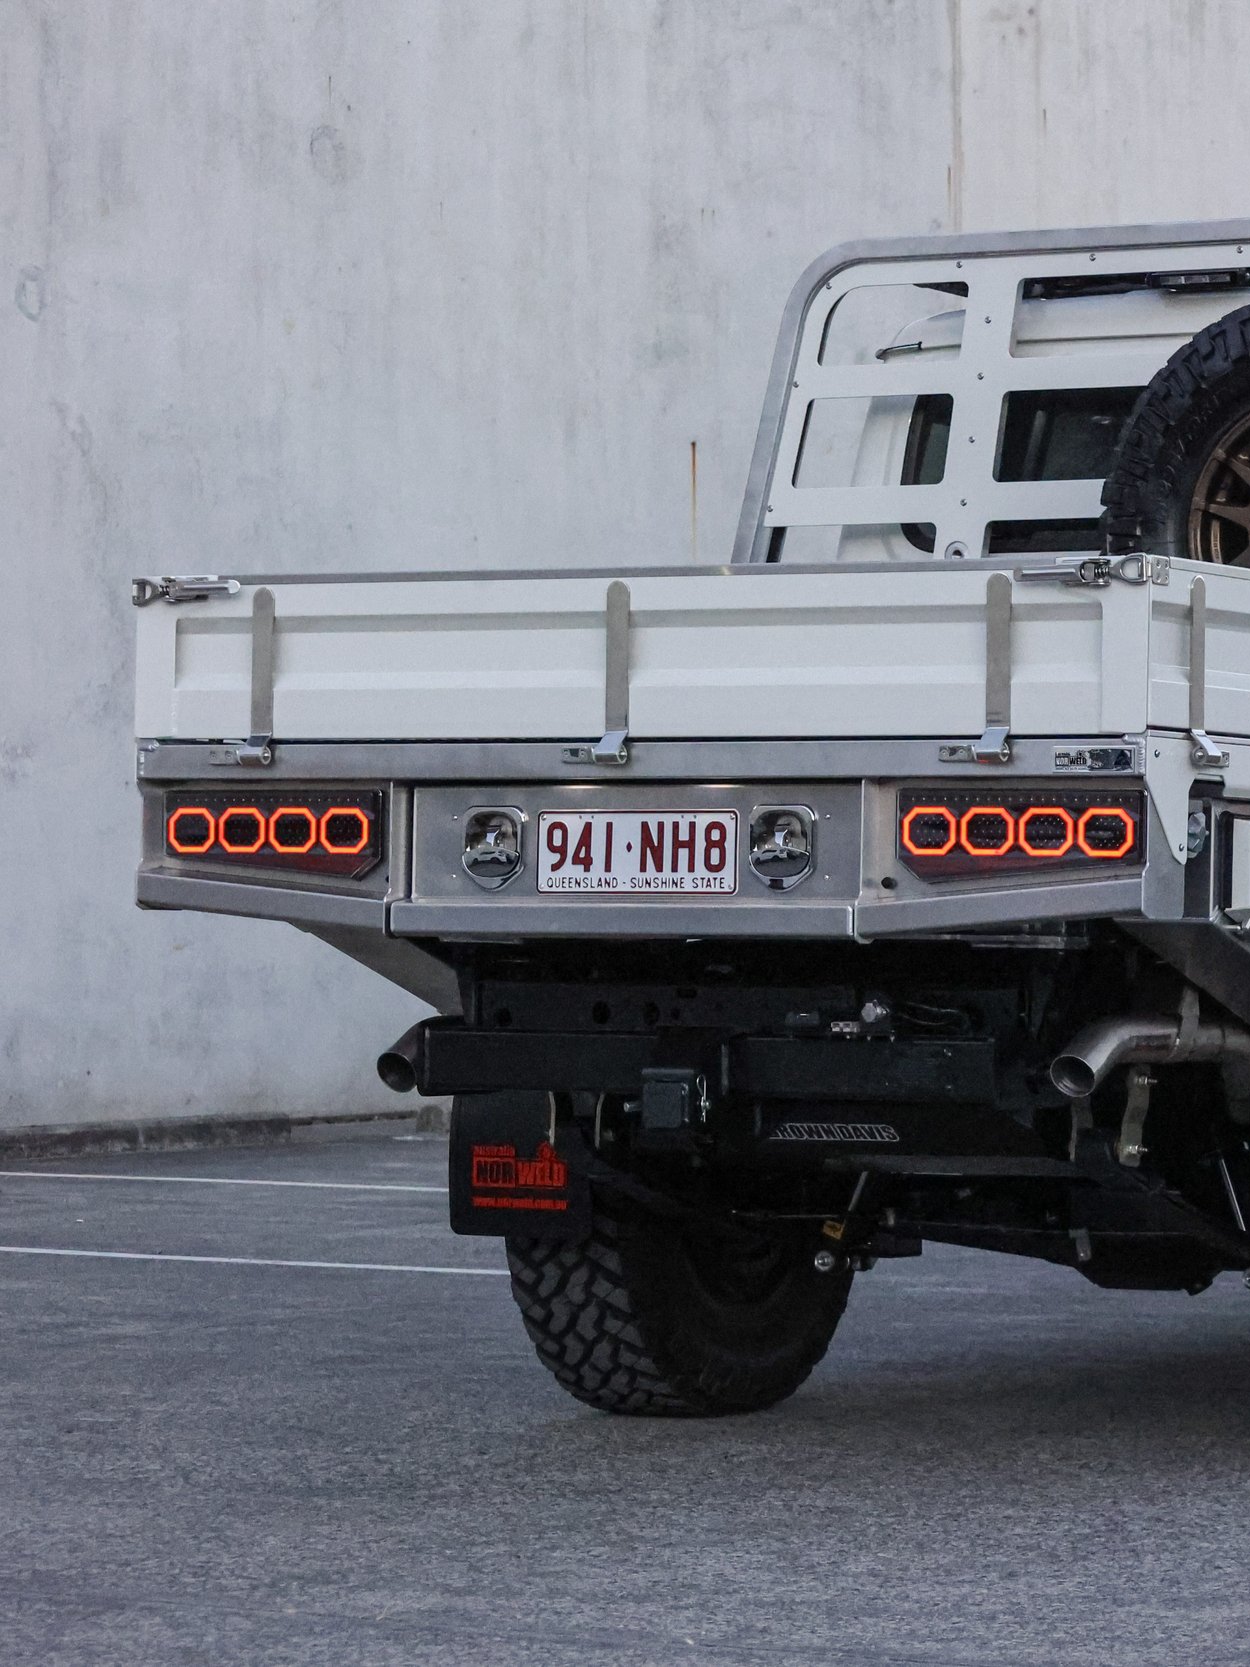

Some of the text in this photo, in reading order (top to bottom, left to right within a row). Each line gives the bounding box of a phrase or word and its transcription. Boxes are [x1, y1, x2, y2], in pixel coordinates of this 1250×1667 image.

[546, 821, 727, 873] 941 NH8
[546, 877, 619, 889] QUEENSLAND
[630, 877, 686, 889] SUNSHINE
[692, 877, 726, 889] STATE
[769, 1122, 900, 1142] ROWN DAVIS
